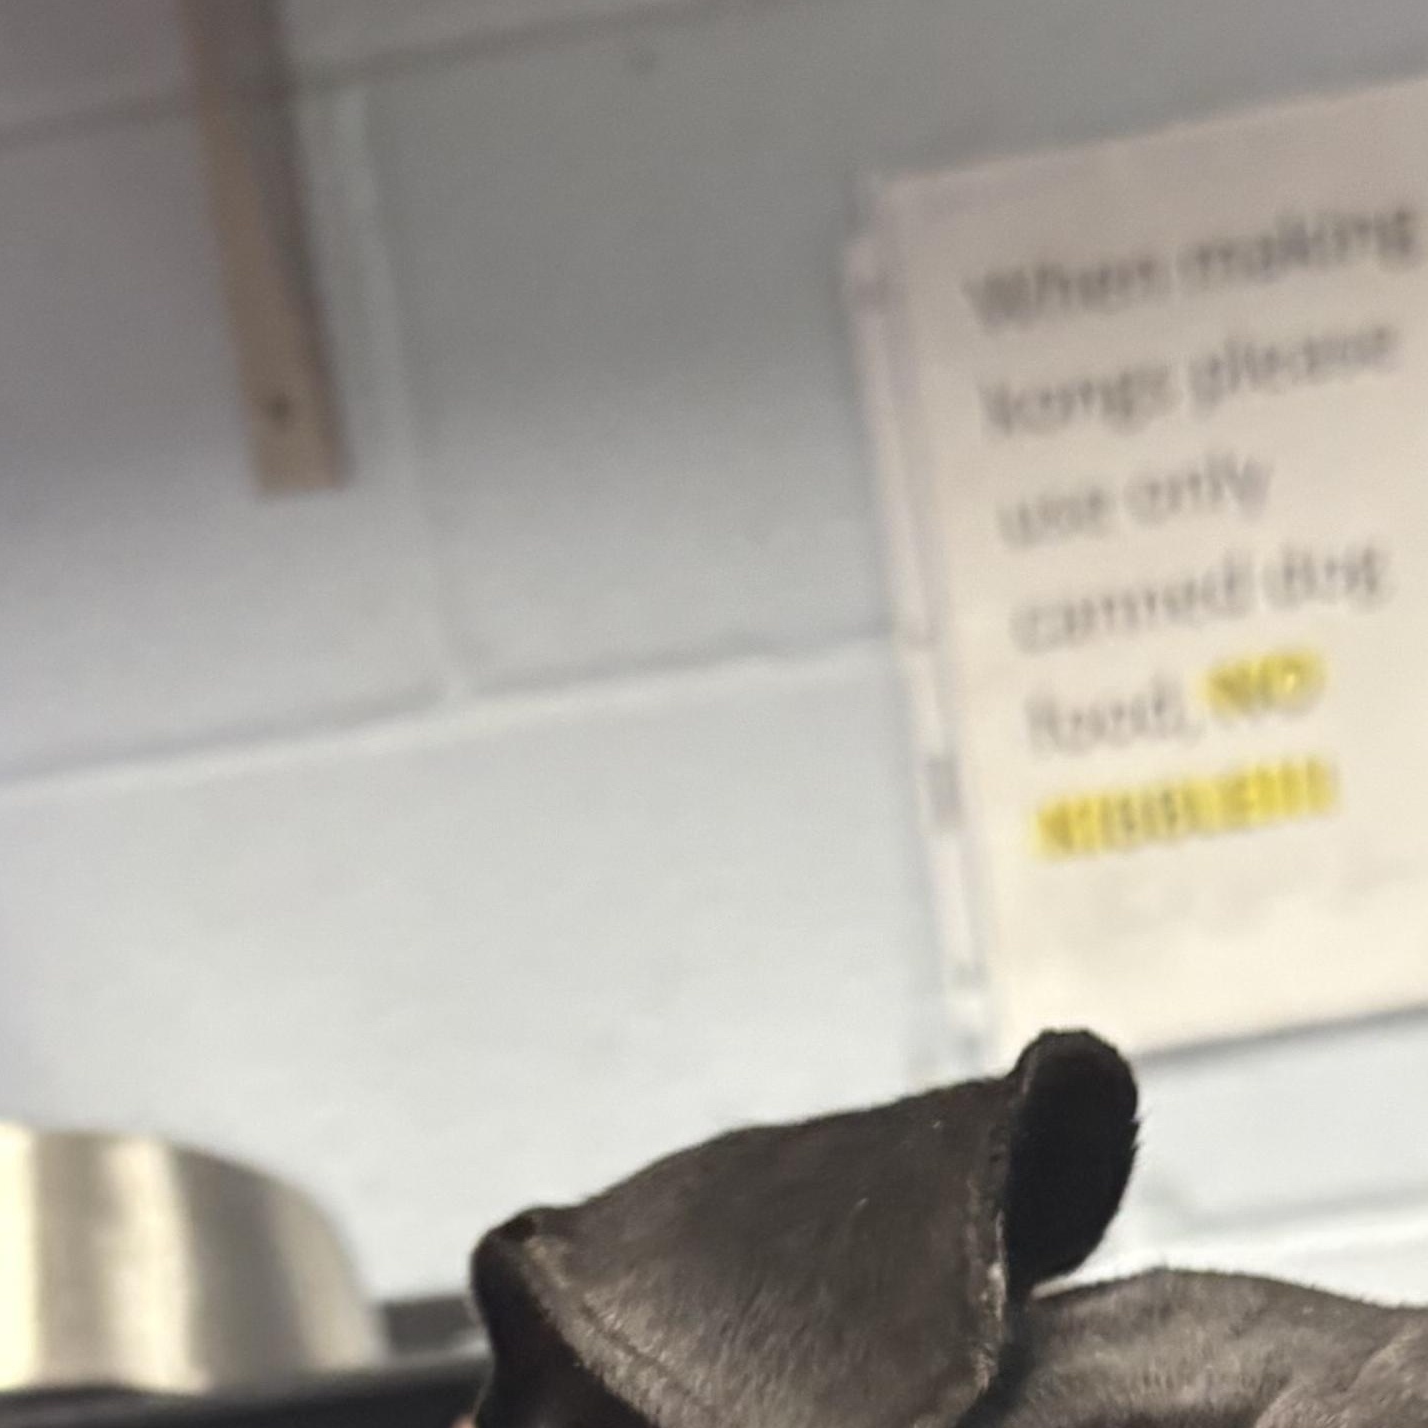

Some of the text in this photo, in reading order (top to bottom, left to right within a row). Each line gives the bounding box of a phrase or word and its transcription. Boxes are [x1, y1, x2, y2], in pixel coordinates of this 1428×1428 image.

[967, 210, 1422, 327] When making
[1192, 328, 1398, 412] please
[999, 454, 1272, 548] use only
[1212, 651, 1324, 718] NO
